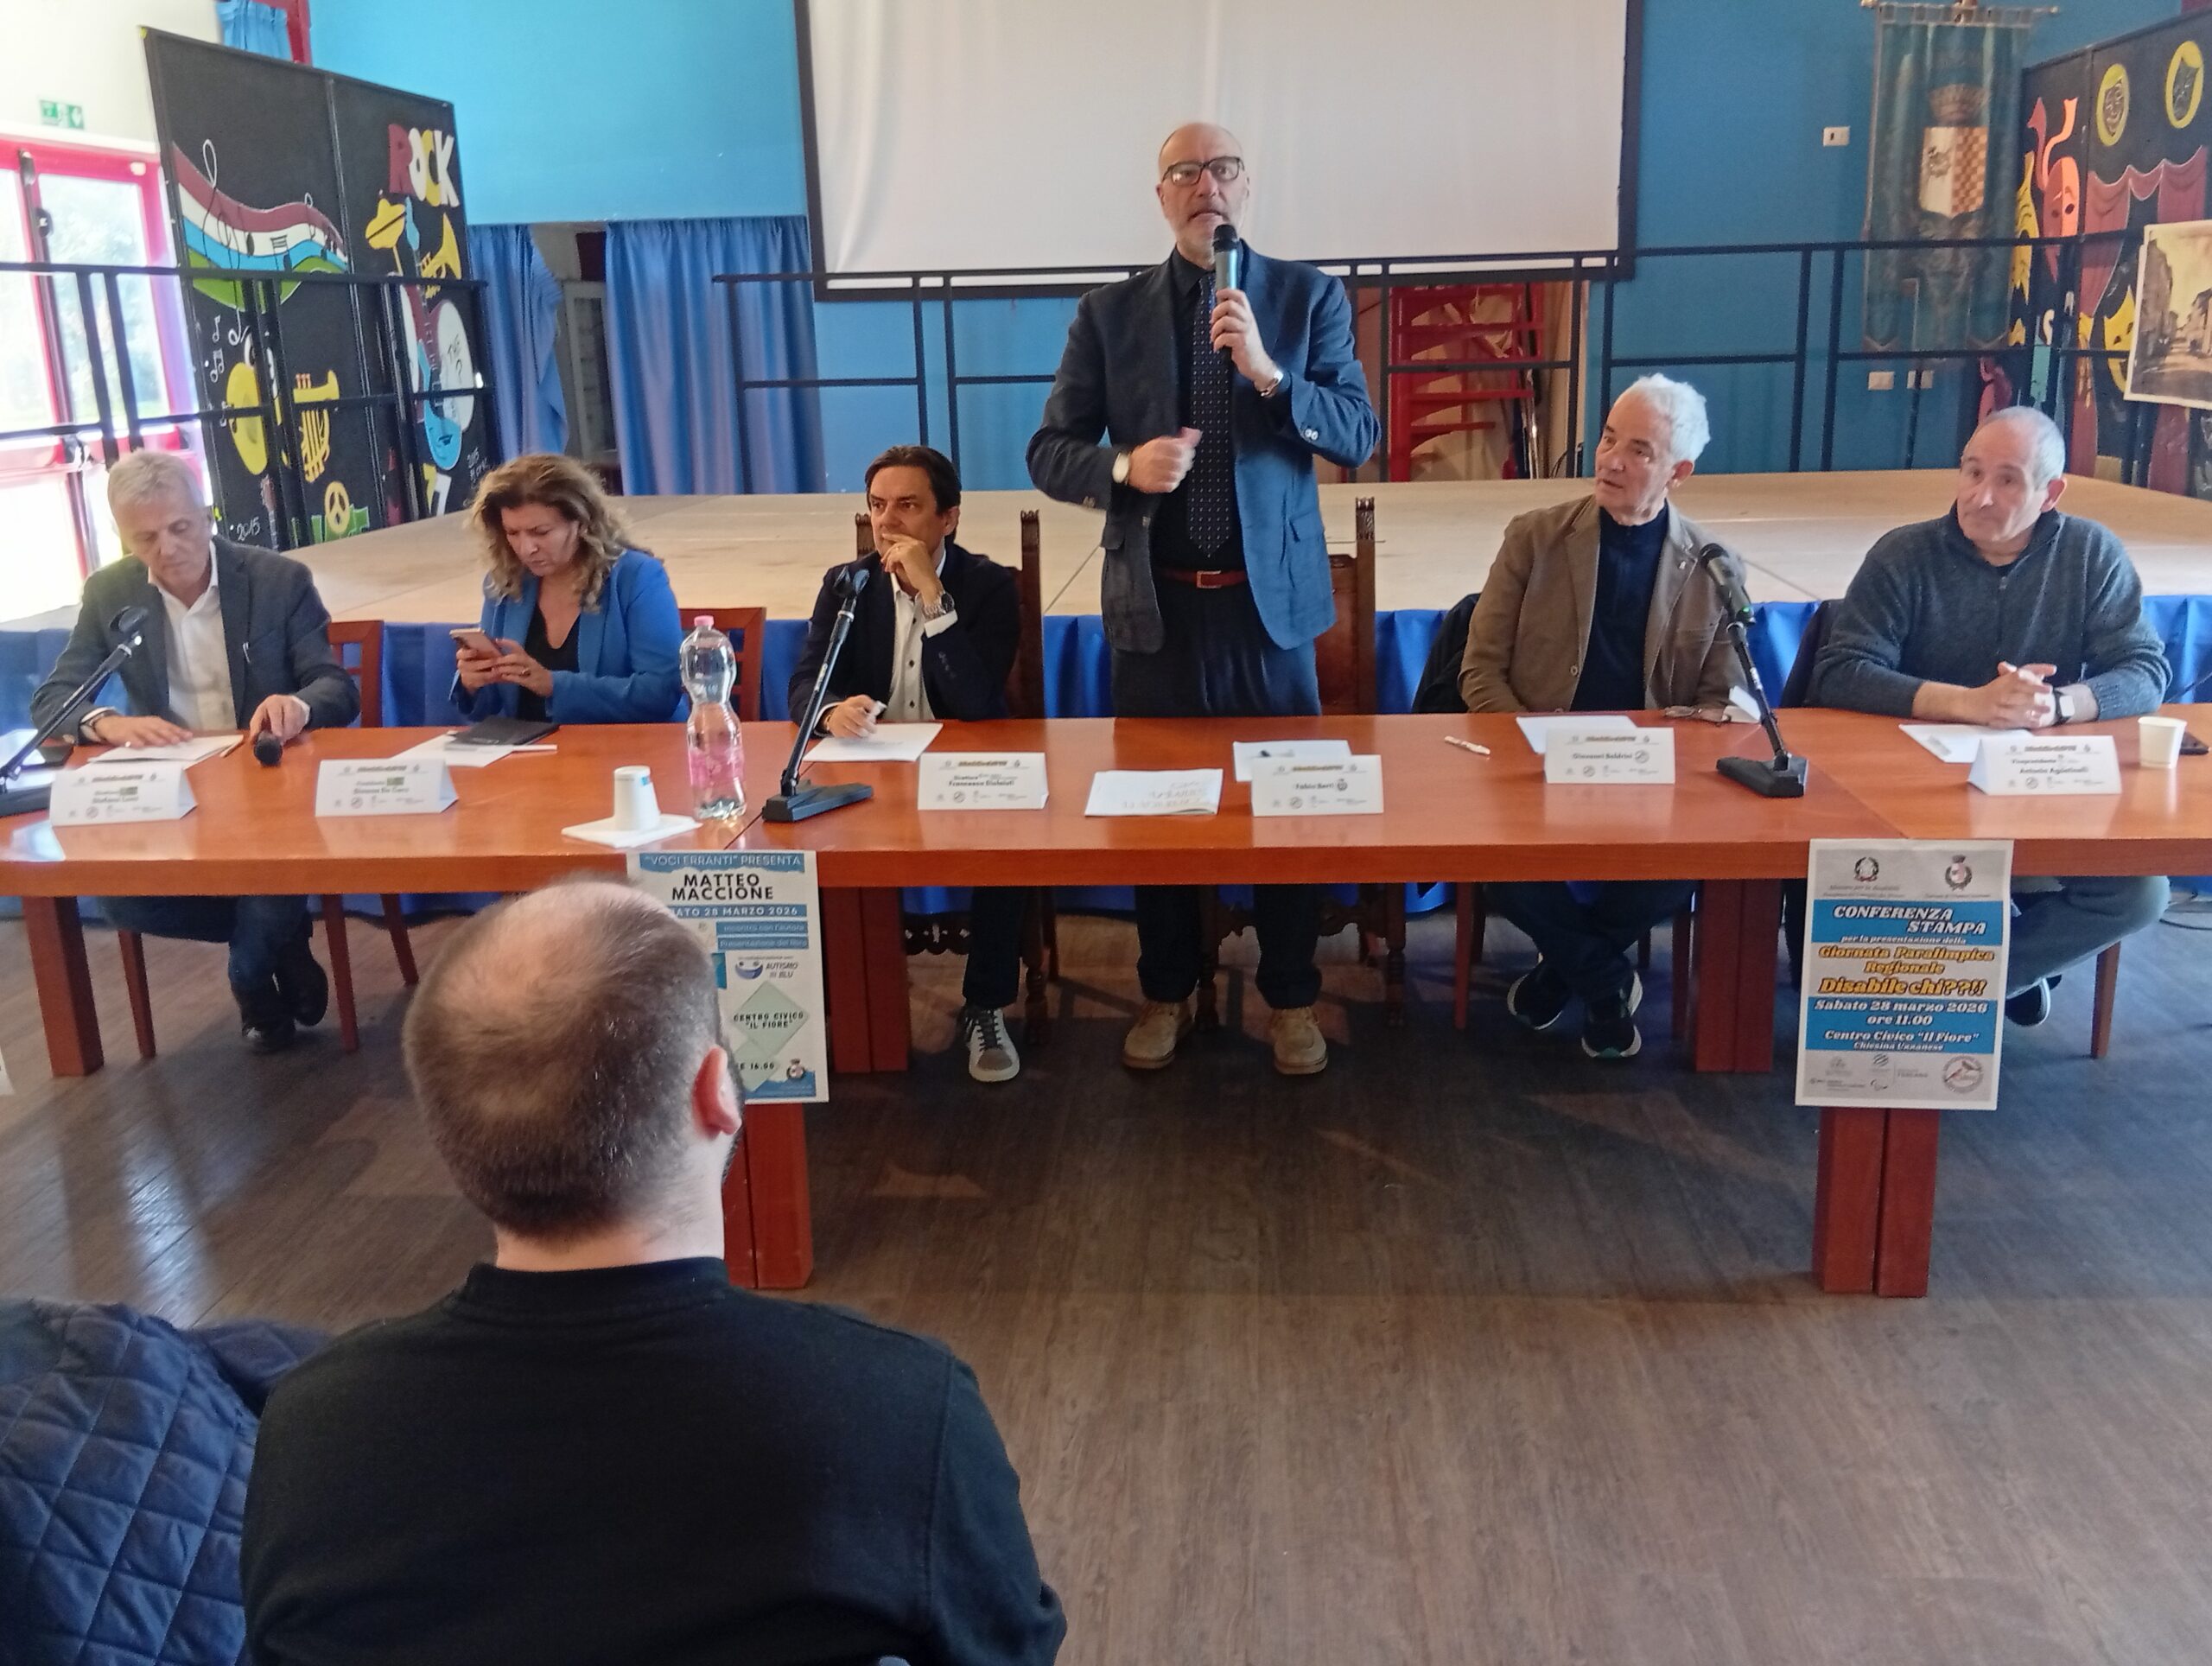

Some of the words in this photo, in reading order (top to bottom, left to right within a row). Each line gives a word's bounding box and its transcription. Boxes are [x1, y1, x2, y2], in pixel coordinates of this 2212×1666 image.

[389, 124, 460, 207] ROCK
[237, 517, 260, 542] 2015
[741, 855, 802, 866] PRESENTA
[683, 874, 760, 887] MATTEO
[672, 887, 774, 900] MACCIONE
[704, 907, 719, 917] 28
[722, 907, 764, 917] MARZO
[769, 906, 798, 916] 2026
[1834, 906, 1954, 921] CONFERENZA
[1907, 920, 1987, 935] STAMPA
[1840, 934, 1858, 944] per
[1859, 934, 1868, 943] la
[1869, 934, 1940, 944] presentazione
[1942, 936, 1967, 945] della
[1819, 945, 1891, 959] Giornata
[1894, 946, 1995, 963] Paralimpica
[1864, 961, 1946, 976] Regionale
[1819, 977, 1907, 995] Disabile
[1815, 999, 1868, 1012] Sabato
[1870, 1000, 1891, 1012] 28
[1892, 1002, 1944, 1013] marzo
[1947, 1002, 1988, 1014] 2026
[734, 1013, 769, 1022] CENTRO
[773, 1011, 804, 1021] CIVICO
[1866, 1016, 1892, 1025] ore
[1895, 1014, 1934, 1026] 11.00
[1825, 1029, 1871, 1040] Centro
[1873, 1030, 1915, 1042] Civico
[1853, 1041, 1895, 1051] Chiesina
